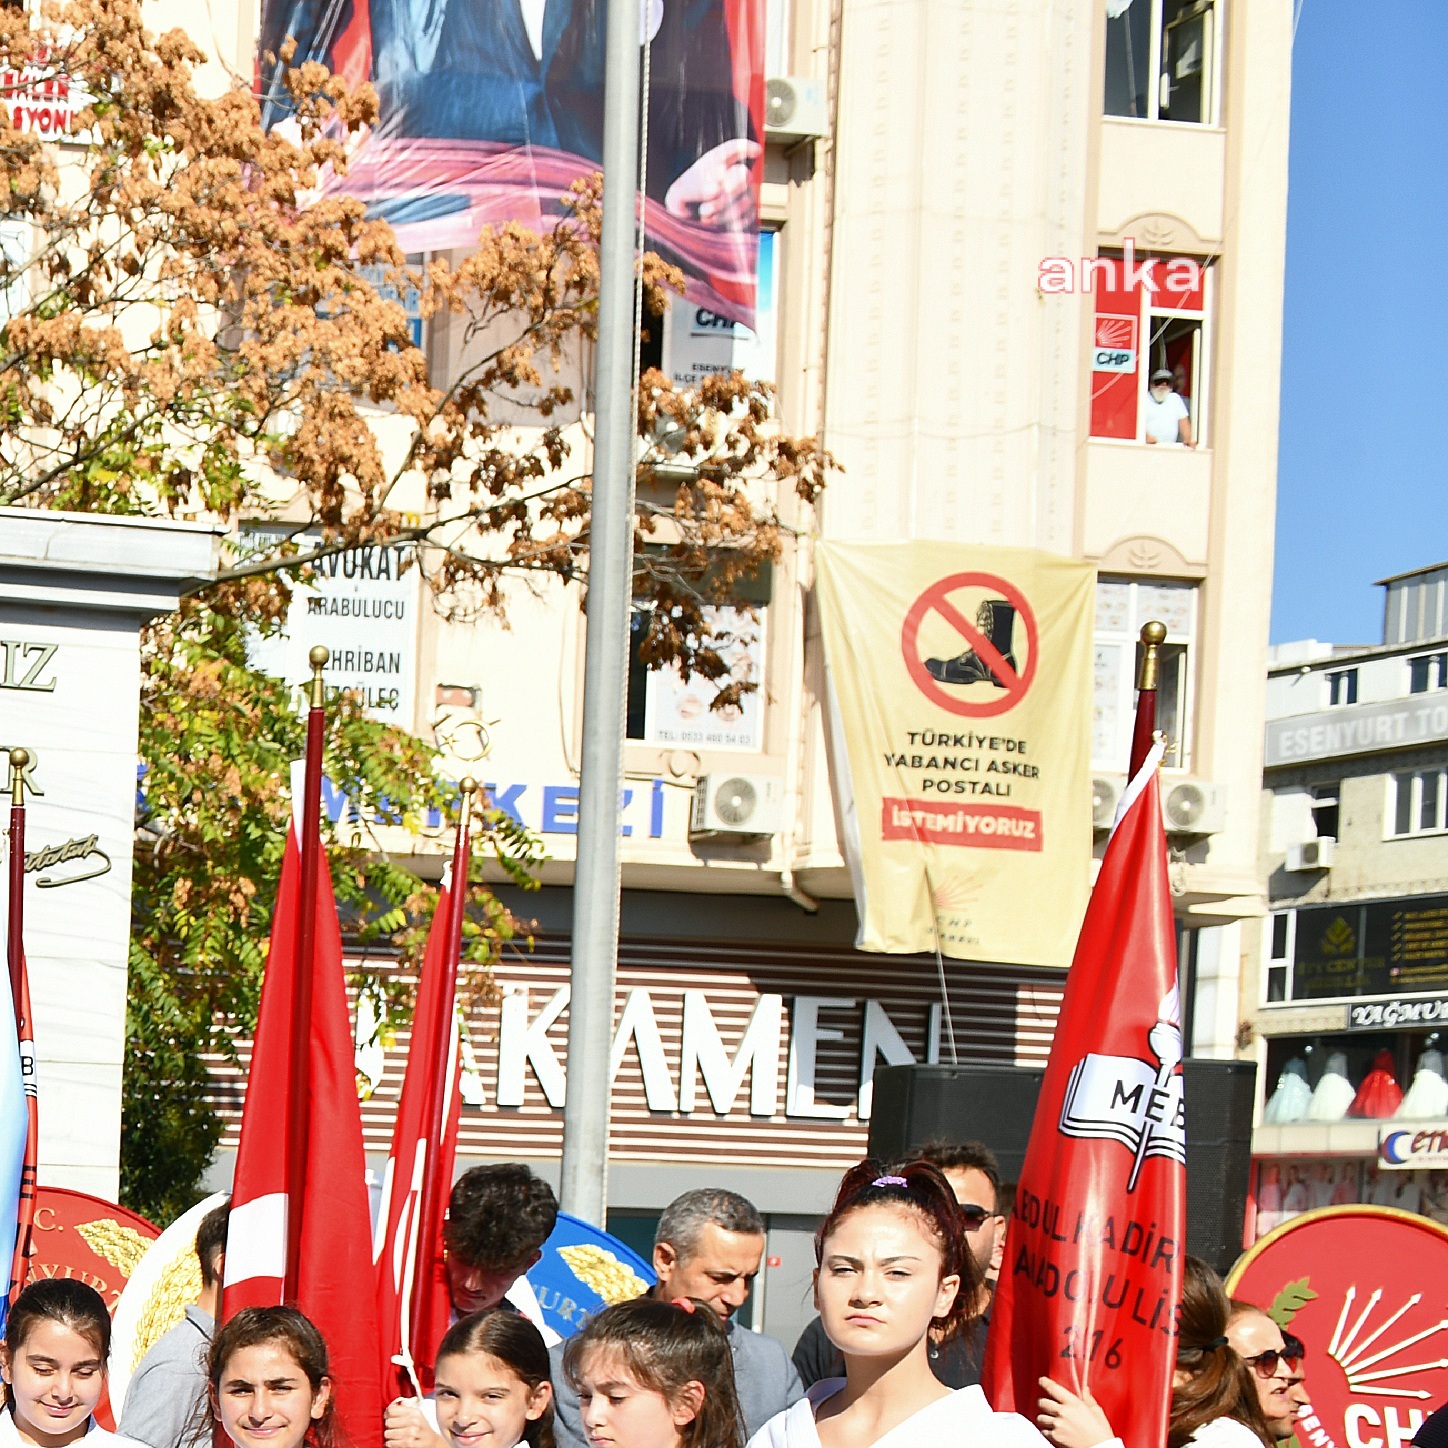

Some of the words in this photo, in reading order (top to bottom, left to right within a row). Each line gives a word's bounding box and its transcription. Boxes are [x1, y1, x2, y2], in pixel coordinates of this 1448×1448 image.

[696, 308, 736, 329] CH
[1097, 352, 1130, 365] CHP
[307, 597, 405, 620] ARABULUCU
[907, 728, 1026, 755] TÜRKİYE'DE
[1279, 712, 1409, 758] ESENYURT
[884, 753, 979, 772] YABANCI
[987, 760, 1040, 779] ASKER
[922, 778, 1012, 797] POSTALI
[892, 804, 1036, 839] İSTEMİYORUZ
